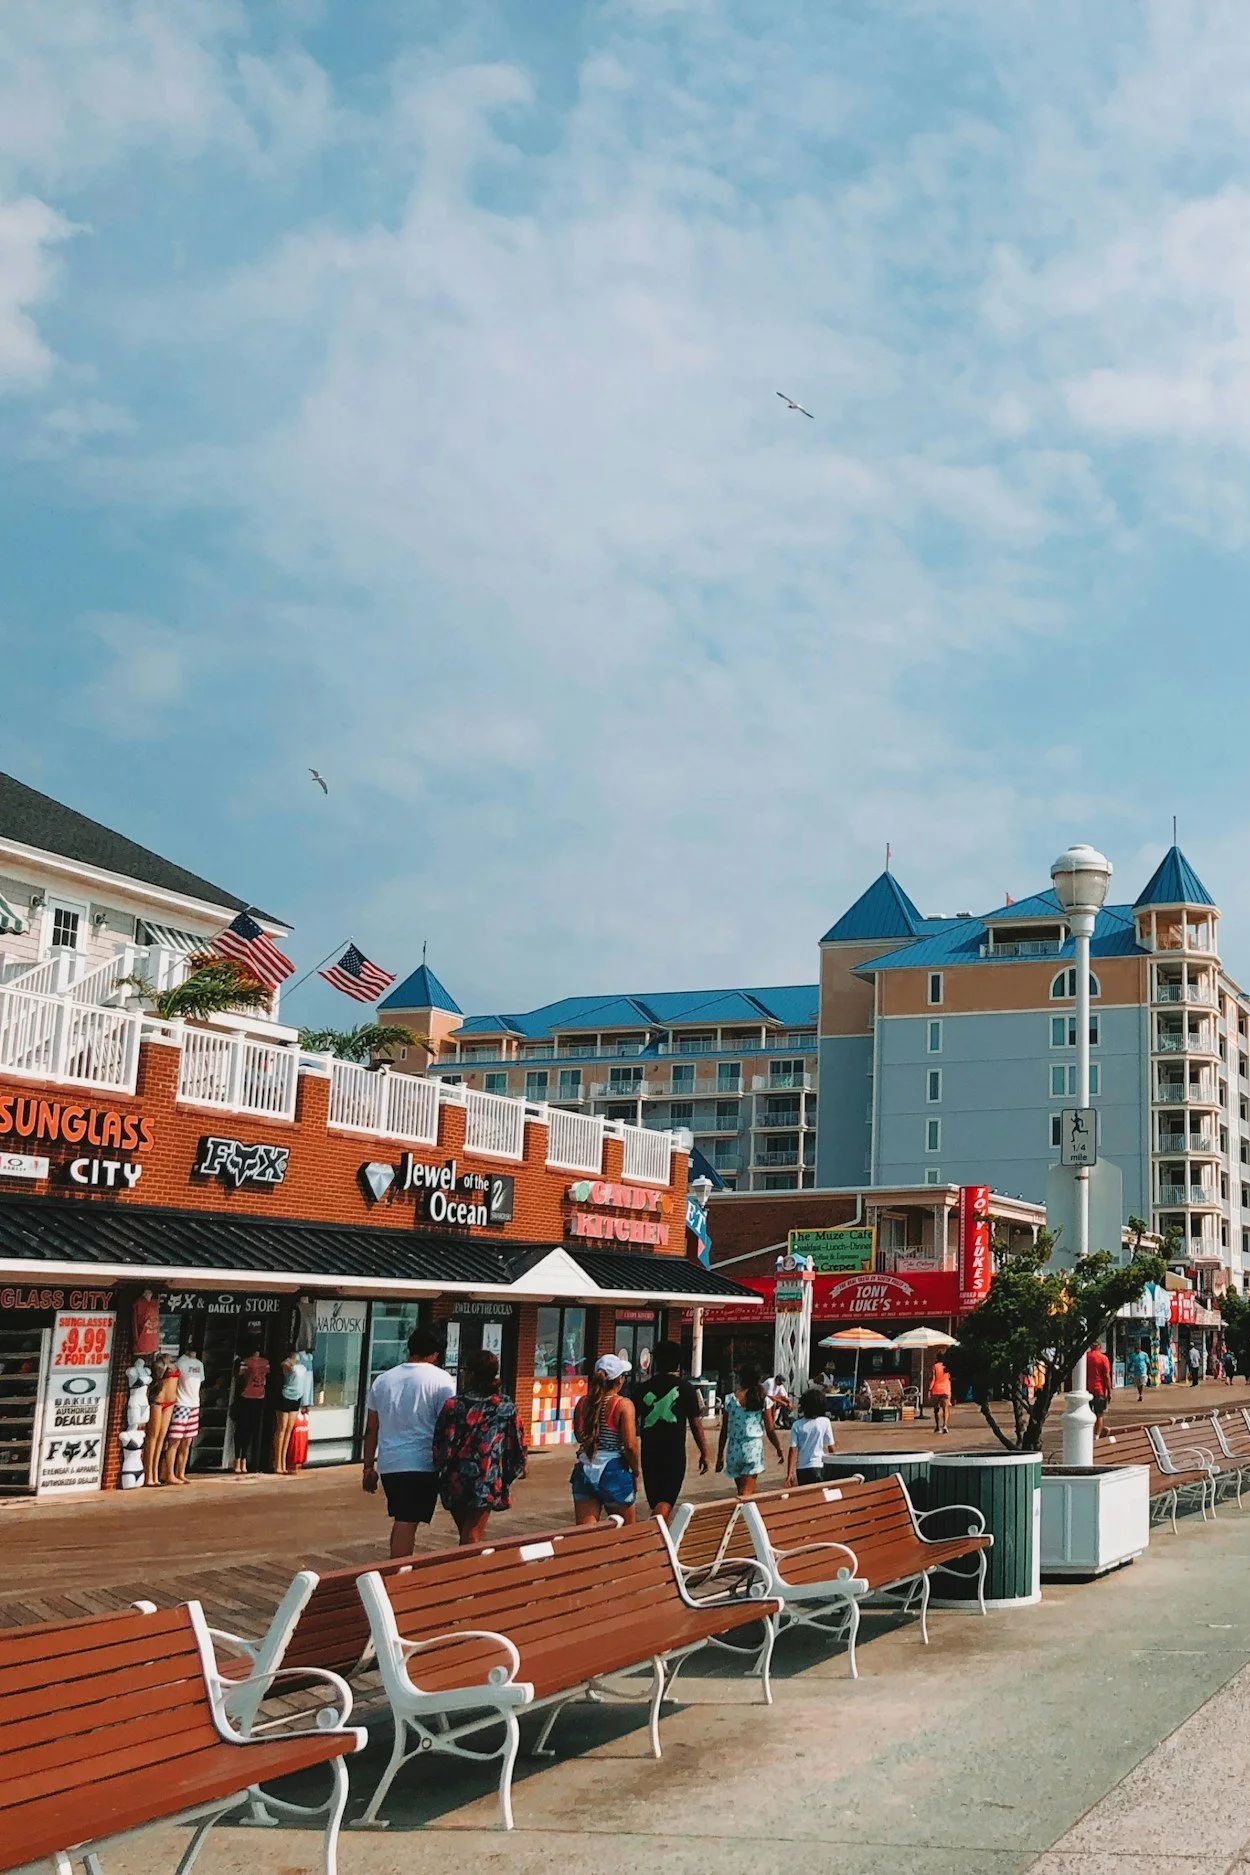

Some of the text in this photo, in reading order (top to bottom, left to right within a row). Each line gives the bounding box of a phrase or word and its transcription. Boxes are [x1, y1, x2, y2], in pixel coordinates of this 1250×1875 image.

[0, 1096, 155, 1151] SUNGLASS
[70, 1158, 142, 1188] CITY
[403, 1152, 490, 1191] Jewel of the
[590, 1182, 662, 1212] CANDY
[430, 1191, 488, 1226] Ocean
[574, 1213, 669, 1245] KITCHEN
[791, 1231, 811, 1241] The
[815, 1231, 844, 1241] Muze
[821, 1262, 856, 1271] Crepes
[973, 1236, 986, 1289] LUKES
[69, 1290, 113, 1309] CITY
[856, 1285, 889, 1299] TONY
[197, 1298, 205, 1309] &
[208, 1304, 242, 1314] OAKLEY
[245, 1298, 280, 1313] STORE
[849, 1298, 892, 1312] LUKE'S
[59, 1317, 113, 1327] SUNGLASSES
[317, 1317, 366, 1333] WAROVSKI
[62, 1328, 106, 1353] $9.99
[55, 1354, 62, 1365] 2
[64, 1354, 86, 1365] FOR
[54, 1414, 96, 1427] DEALER
